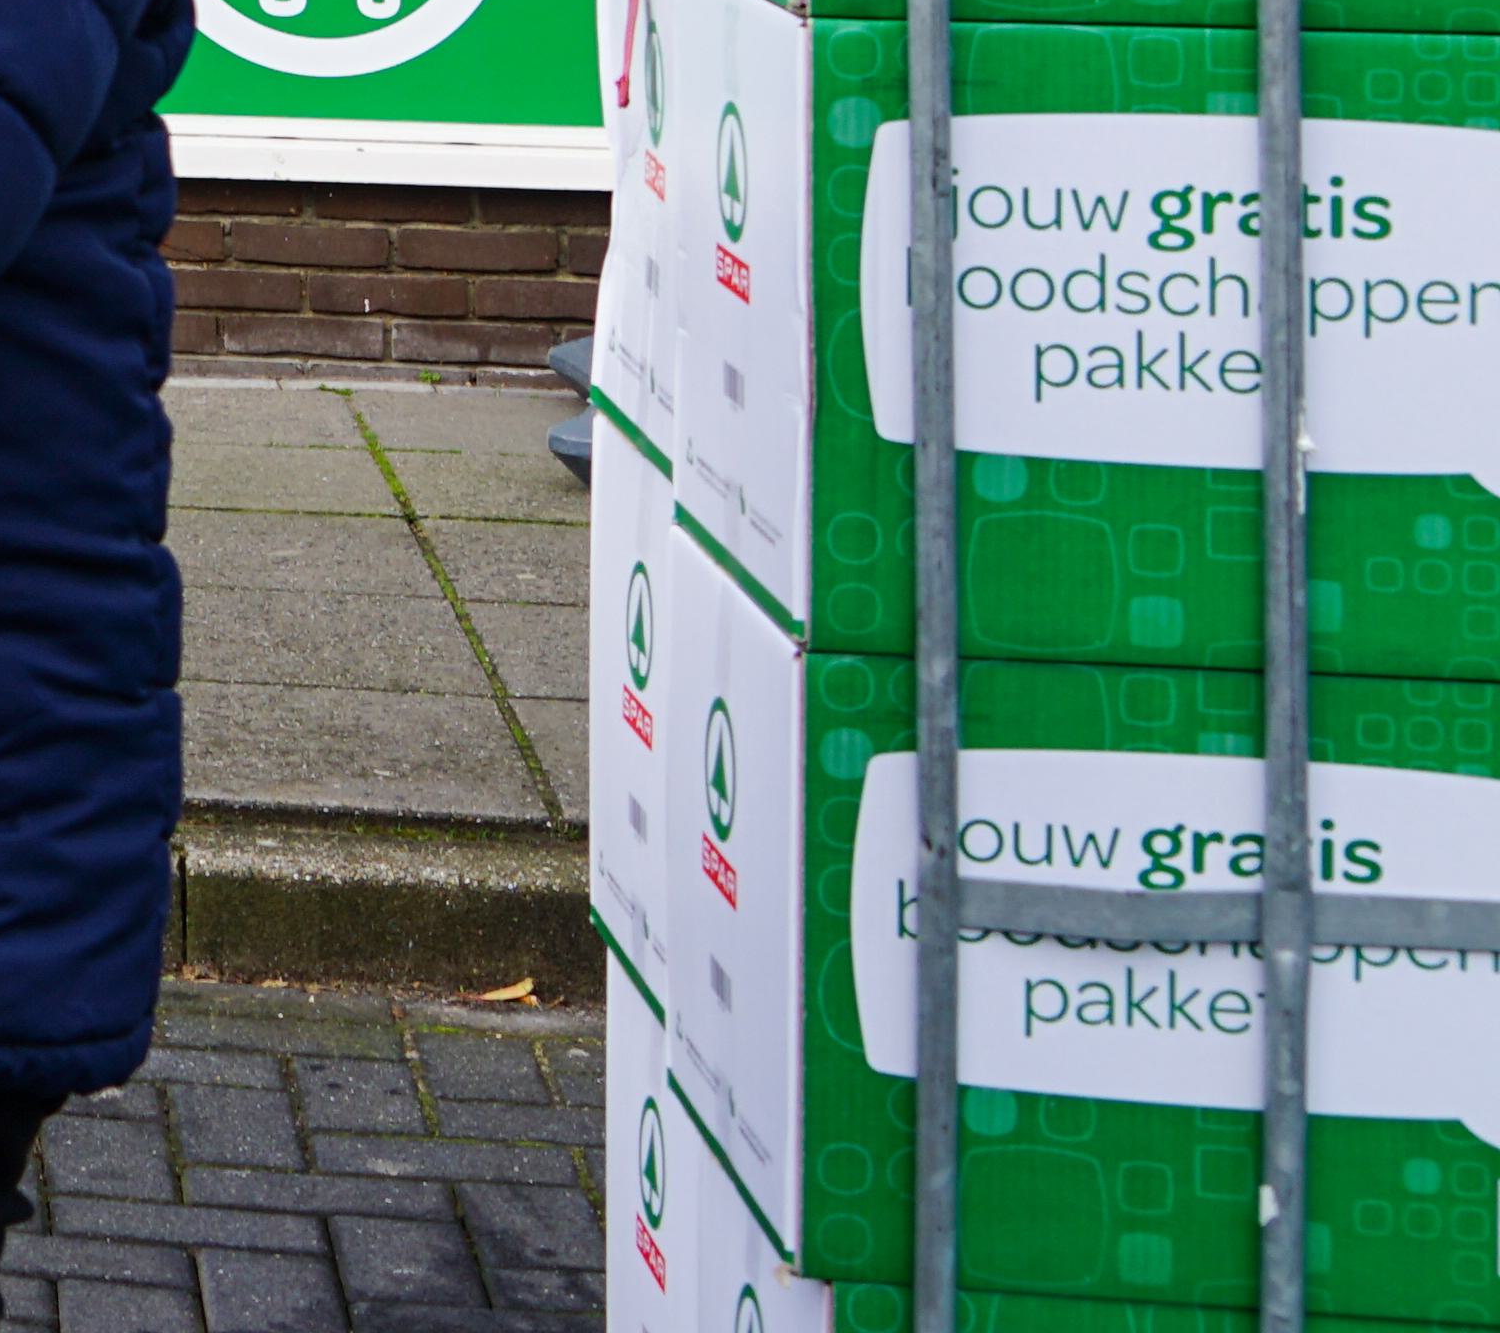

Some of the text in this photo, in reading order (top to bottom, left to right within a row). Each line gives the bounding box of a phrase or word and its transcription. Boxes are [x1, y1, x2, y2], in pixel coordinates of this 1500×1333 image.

[716, 247, 749, 300] SPAR
[907, 246, 1500, 338] oodschppen
[1034, 330, 1265, 404] pakke
[703, 837, 736, 903] SPAR
[958, 818, 1384, 890] ouw grais
[1025, 967, 1267, 1039] pakke
